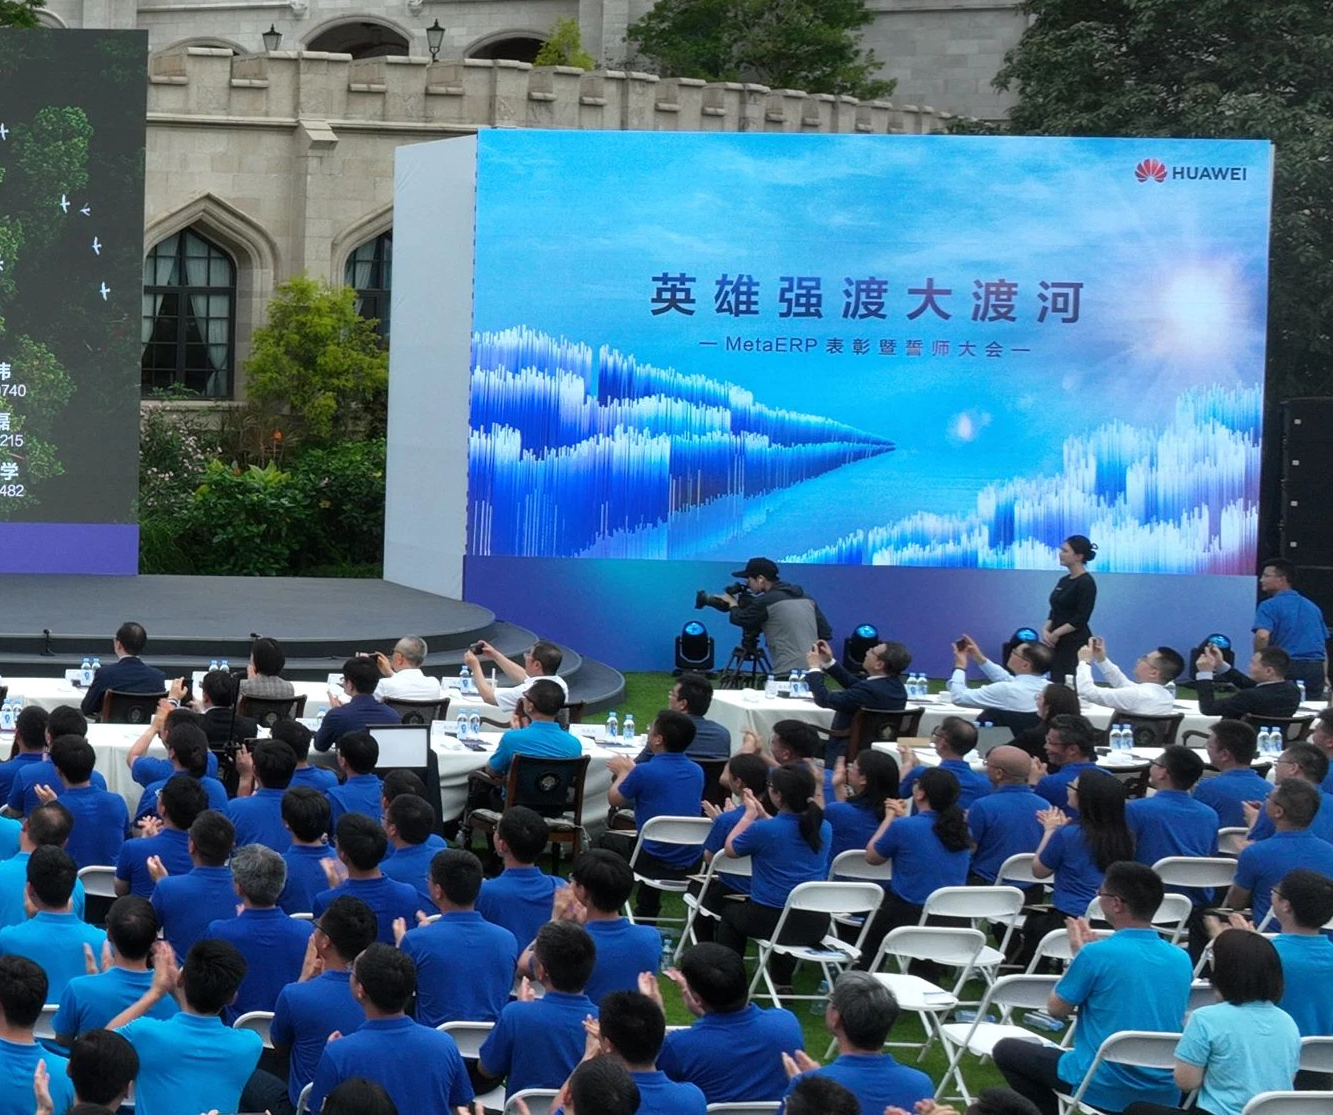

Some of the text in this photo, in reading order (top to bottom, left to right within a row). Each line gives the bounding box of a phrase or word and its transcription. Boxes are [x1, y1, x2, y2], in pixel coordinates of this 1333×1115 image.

[1172, 166, 1247, 181] HUAWEI
[650, 272, 1084, 324] 英雄强渡大渡河
[725, 336, 818, 353] MetaERP
